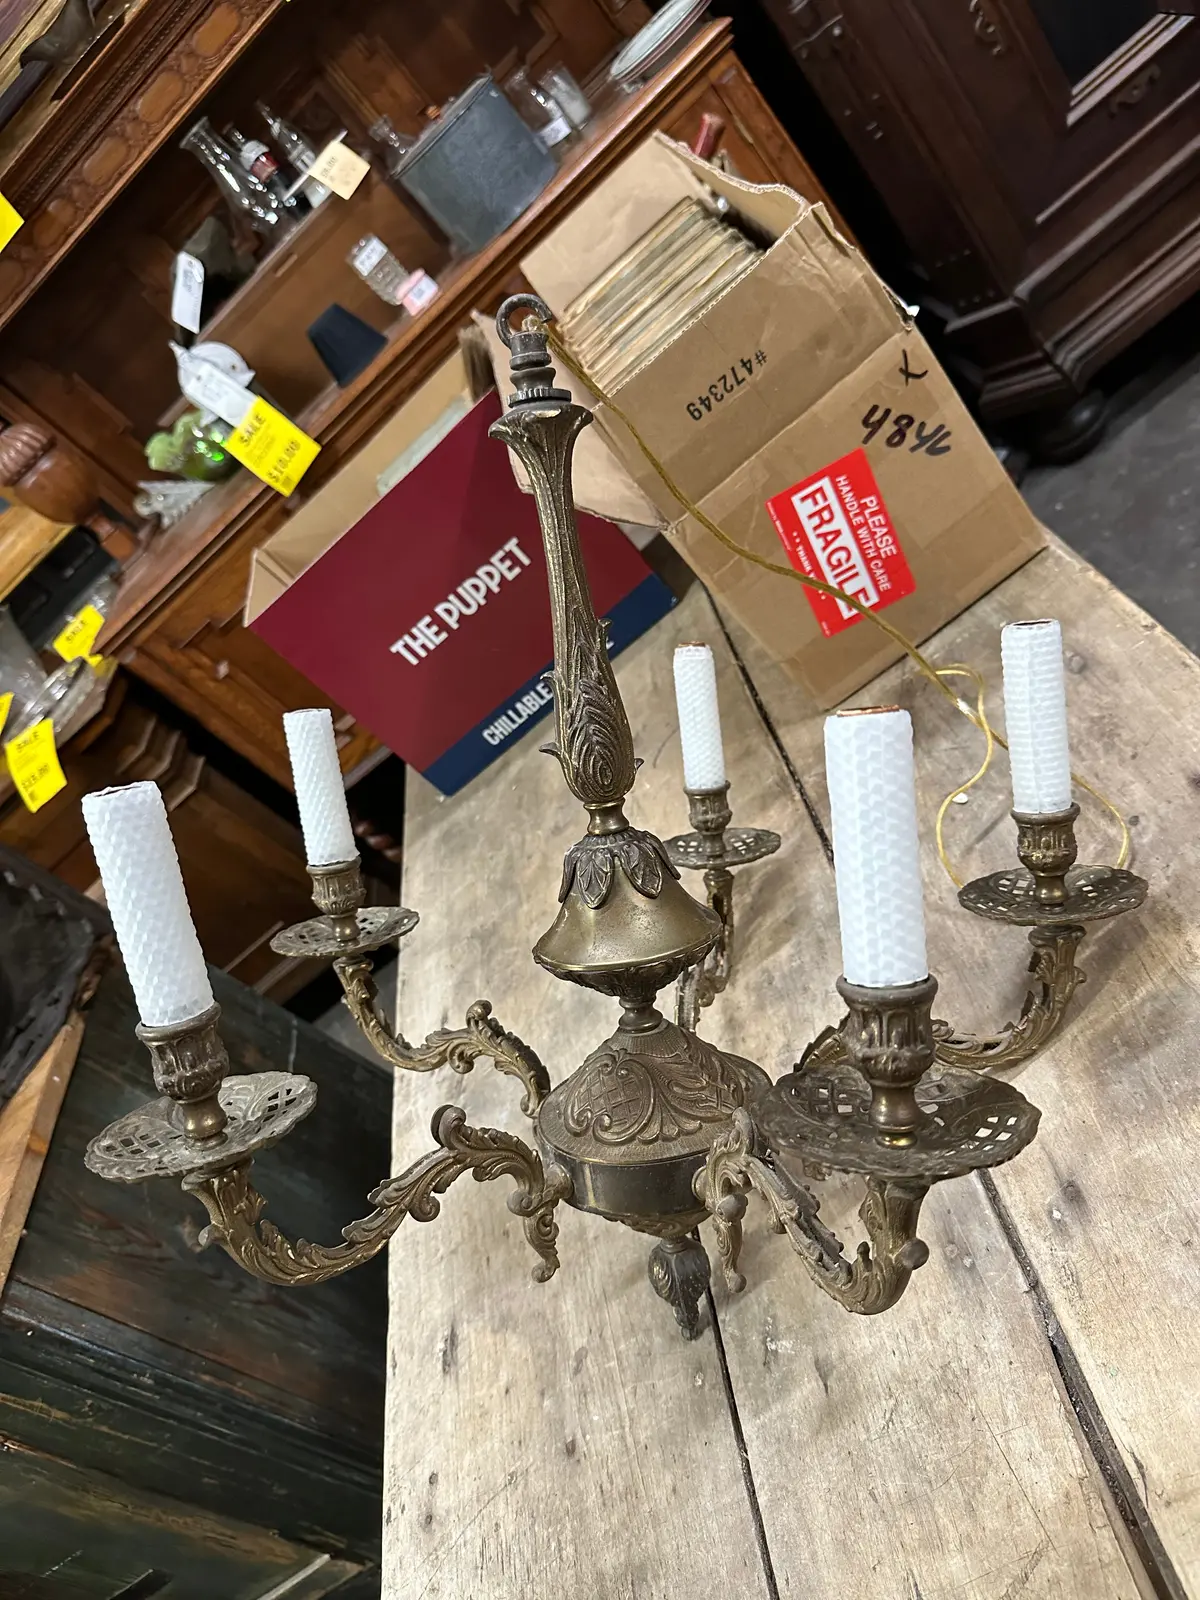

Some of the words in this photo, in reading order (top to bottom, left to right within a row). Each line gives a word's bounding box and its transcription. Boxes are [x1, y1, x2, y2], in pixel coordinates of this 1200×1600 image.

[686, 350, 768, 421] #472349
[239, 411, 268, 447] SALE
[799, 485, 875, 614] FRAGILE
[836, 475, 865, 527] HANDLE
[856, 525, 879, 561] WITH
[869, 559, 893, 592] CARE
[860, 495, 897, 559] PLEASE
[389, 614, 449, 666] THE
[434, 536, 532, 631] PUPPET
[481, 682, 553, 747] CHILLABLE
